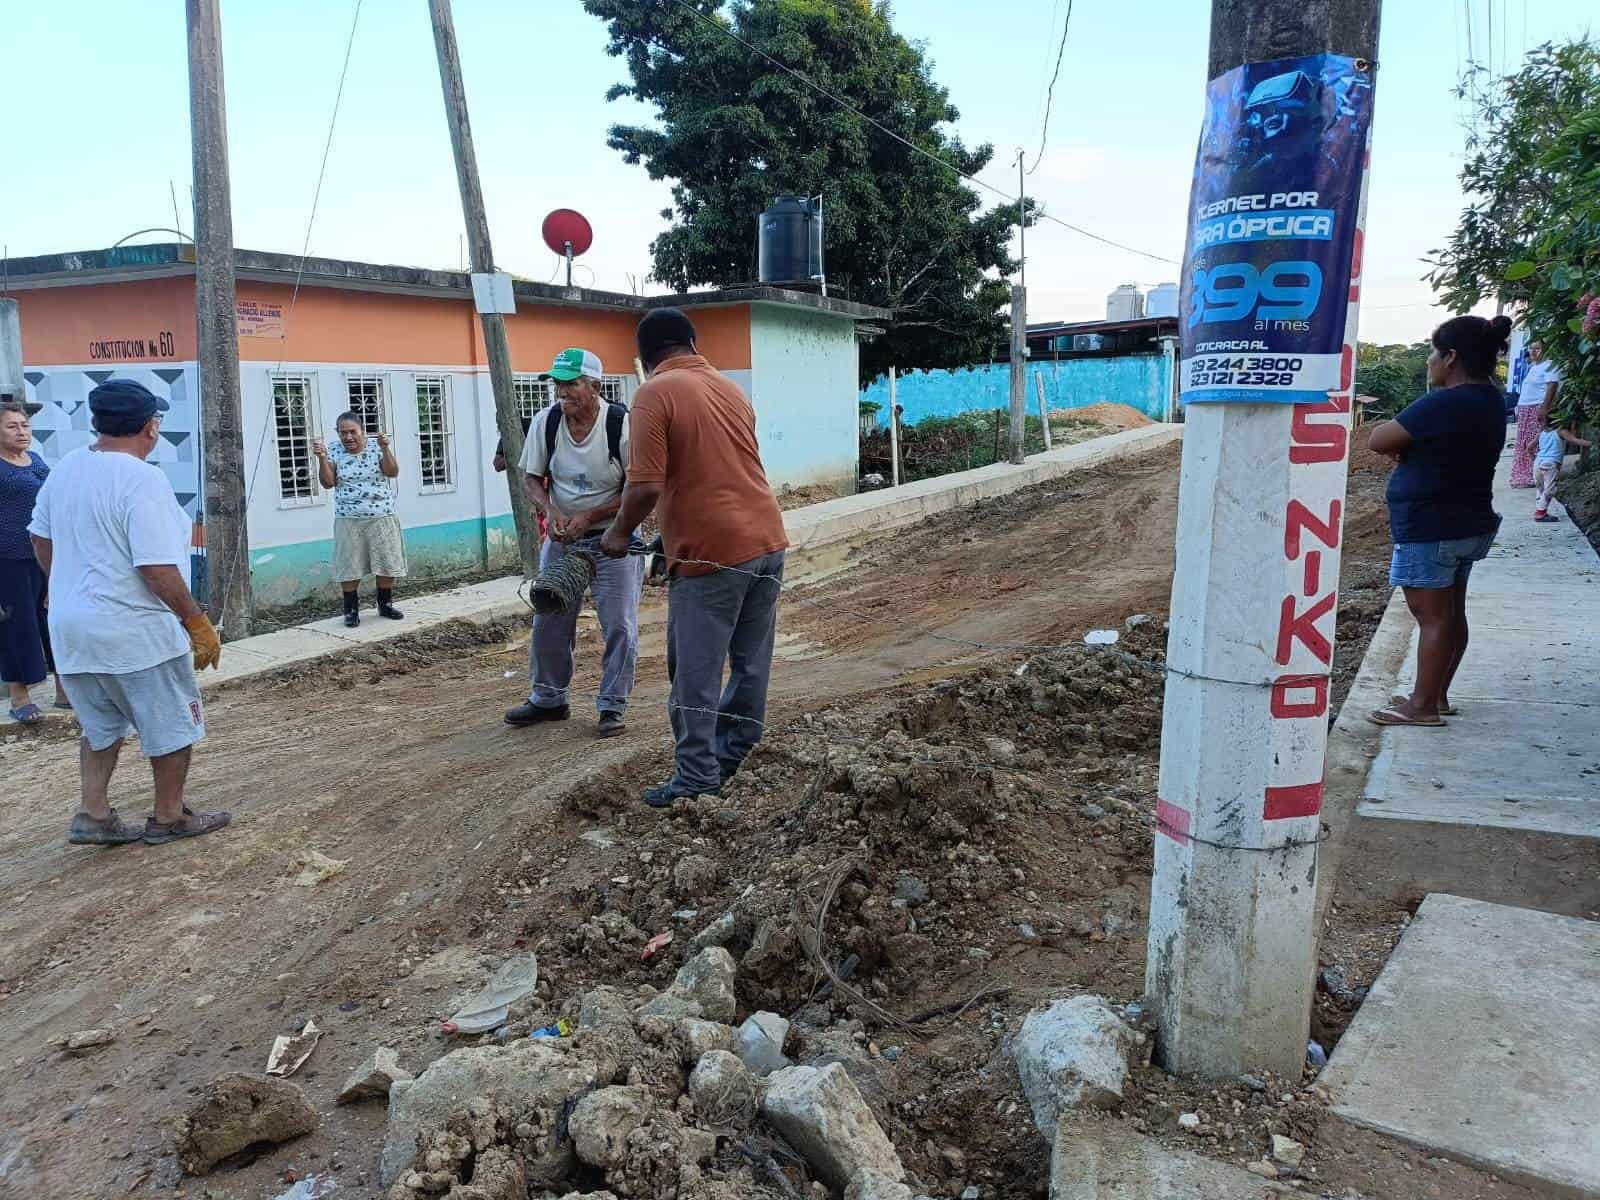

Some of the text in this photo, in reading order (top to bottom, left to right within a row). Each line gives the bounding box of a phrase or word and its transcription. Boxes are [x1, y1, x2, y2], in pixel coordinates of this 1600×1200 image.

[1269, 191, 1319, 209] POR
[1226, 214, 1331, 240] ÓPTICA
[1254, 318, 1310, 332] al mes
[89, 340, 146, 359] CONSTITUCION
[160, 331, 175, 357] 60
[1250, 340, 1269, 350] AL
[1206, 358, 1245, 371] 244
[1246, 358, 1303, 372] 3800
[1210, 372, 1234, 385] 121
[1236, 372, 1294, 386] 2328
